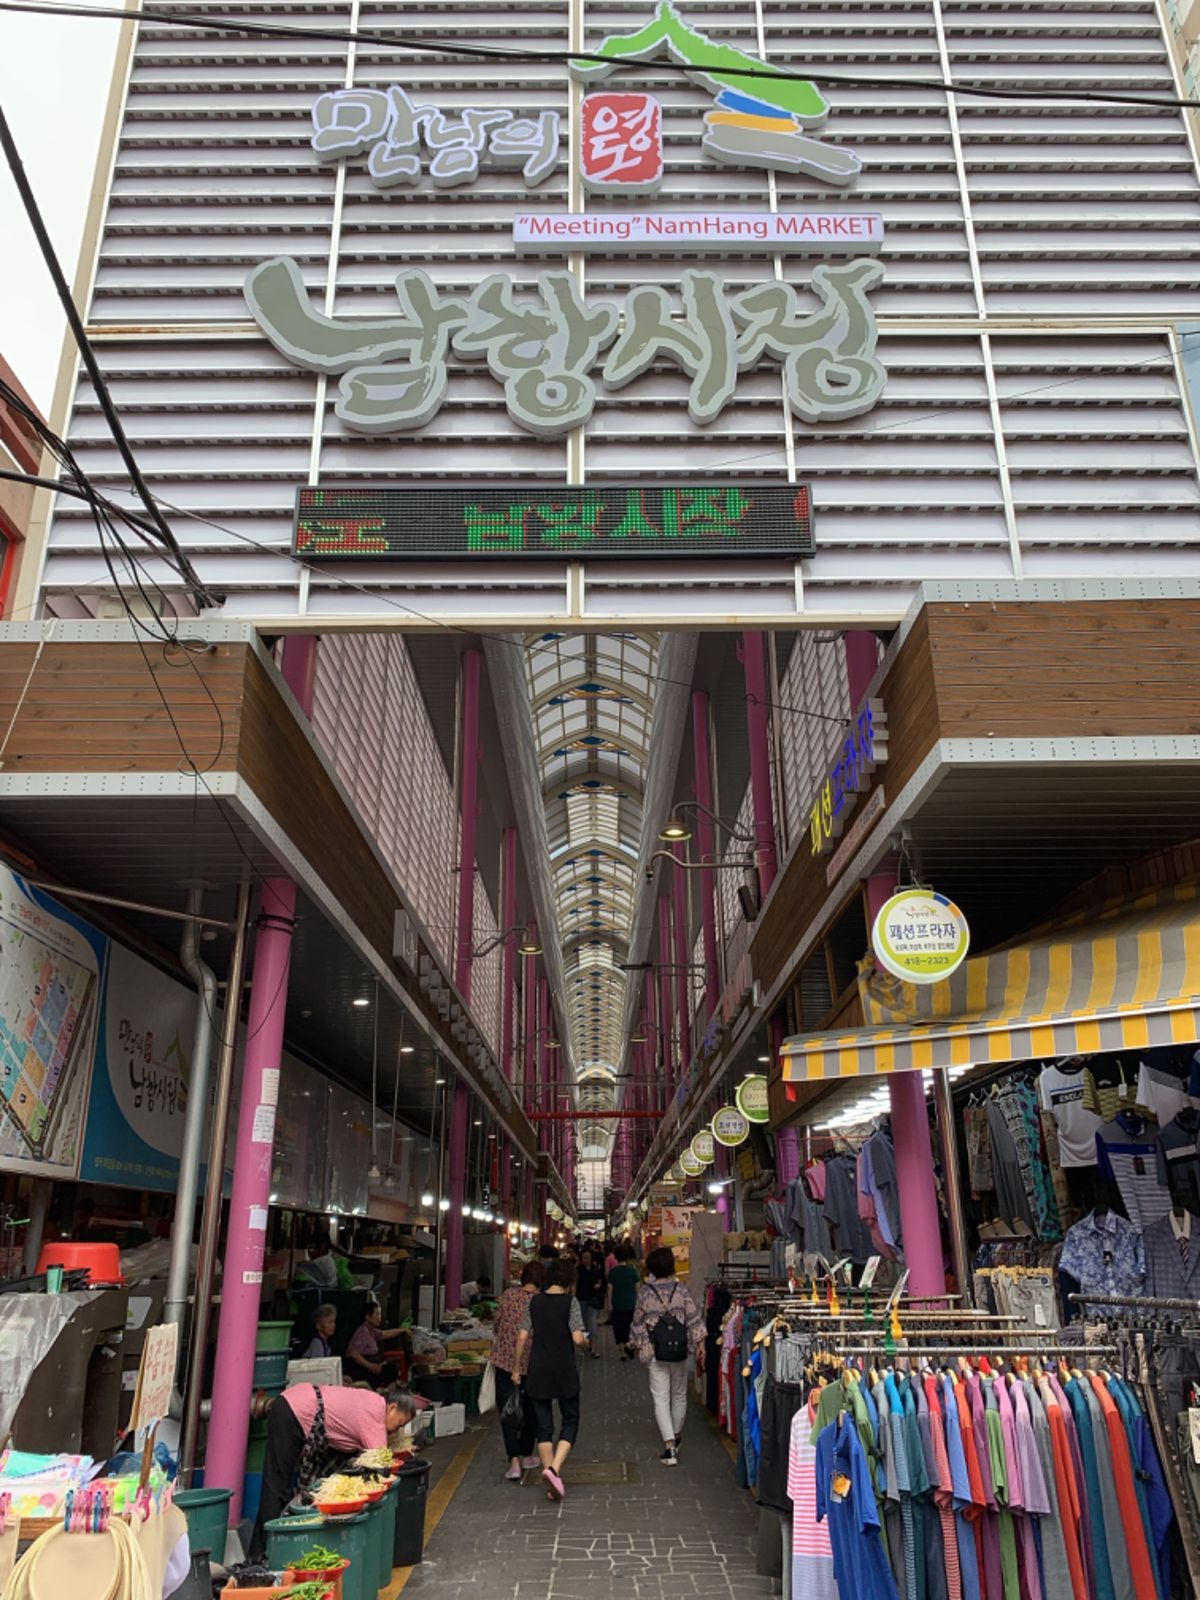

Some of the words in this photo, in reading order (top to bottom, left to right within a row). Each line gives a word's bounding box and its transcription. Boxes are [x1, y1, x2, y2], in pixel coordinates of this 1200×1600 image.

[312, 86, 559, 187] 만남의
[645, 217, 769, 239] NamHang
[775, 217, 877, 235] MARKET
[244, 256, 889, 434] 남항시장
[1059, 1089, 1083, 1102] ENGLA
